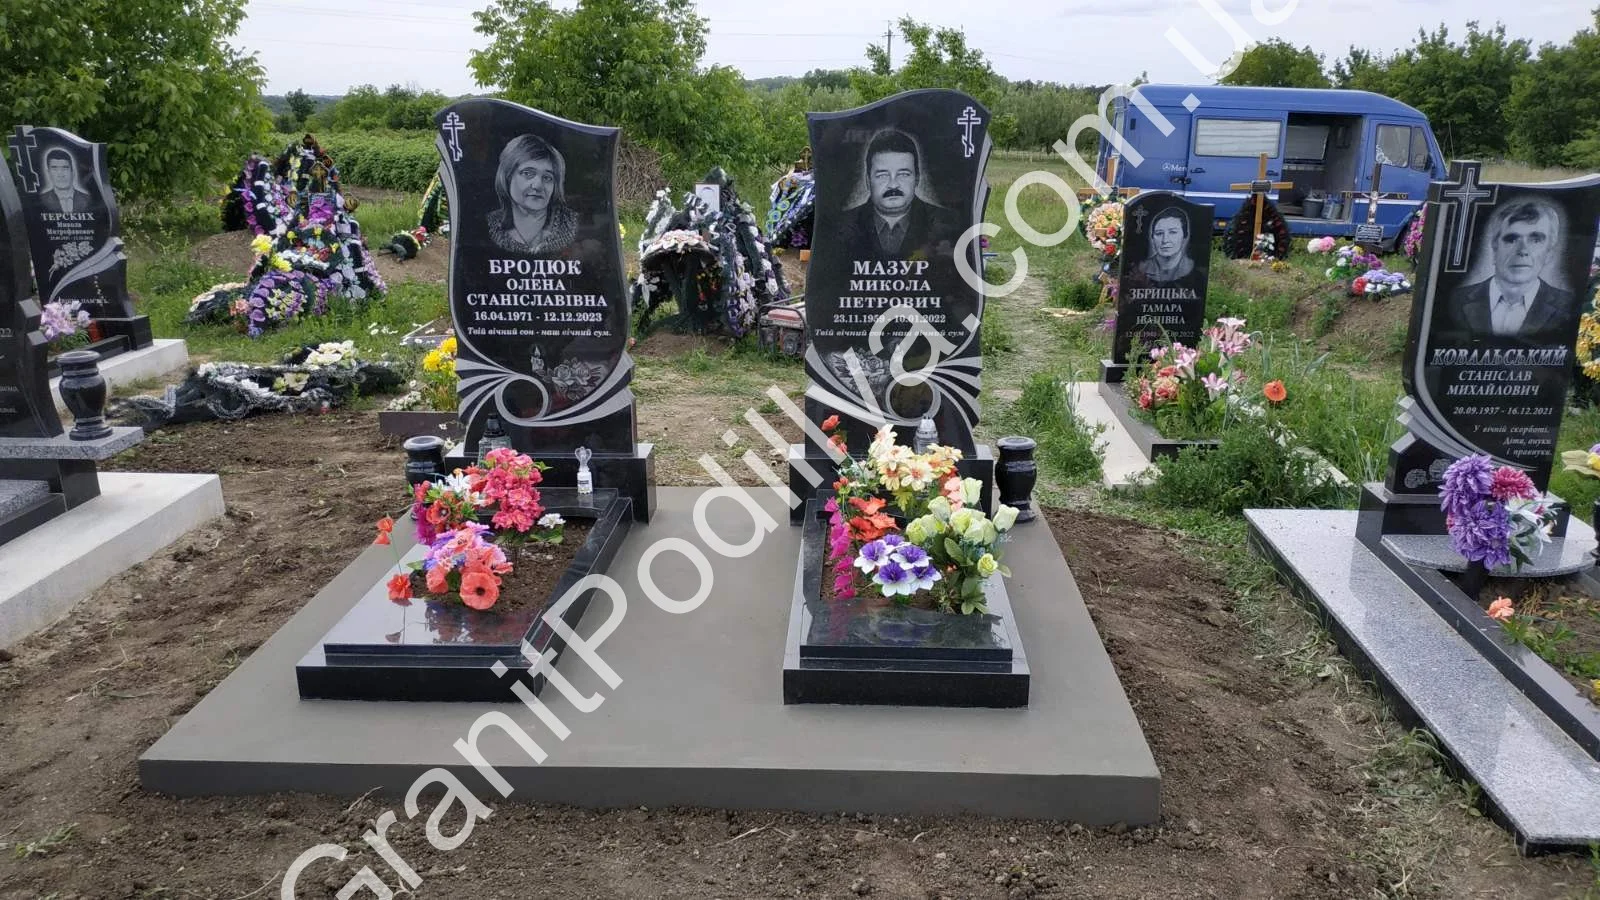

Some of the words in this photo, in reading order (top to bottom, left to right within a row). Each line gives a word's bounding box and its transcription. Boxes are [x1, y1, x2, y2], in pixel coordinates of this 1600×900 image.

[41, 212, 95, 221] ТЕРСКИХ
[488, 259, 582, 278] БРОДЮК
[852, 260, 929, 276] МАЗУР
[506, 278, 566, 291] ОЛЕНА
[849, 279, 931, 292] МИКОЛА
[466, 293, 608, 307] СТАНІСЛАВІВНА
[1129, 288, 1197, 300] ЗБРИЦЬКА
[838, 297, 941, 309] ПЕТРОВИЧ
[1142, 303, 1182, 312] ТАМАРА
[474, 311, 532, 321] 16.04.1971
[543, 312, 603, 322] 12.12.2023
[467, 327, 486, 335] Твій
[562, 328, 592, 336] вічний
[815, 328, 834, 336] Твій
[836, 329, 867, 337] вічний
[1430, 345, 1568, 366] КОВАЛЬСЬКИЙ
[1458, 370, 1532, 381] СТАНІСЛАВ
[1447, 384, 1540, 396] МИХАЙЛОВИЧ
[1453, 407, 1499, 415] 20.09.1937
[1507, 407, 1553, 415] 16.12.2021
